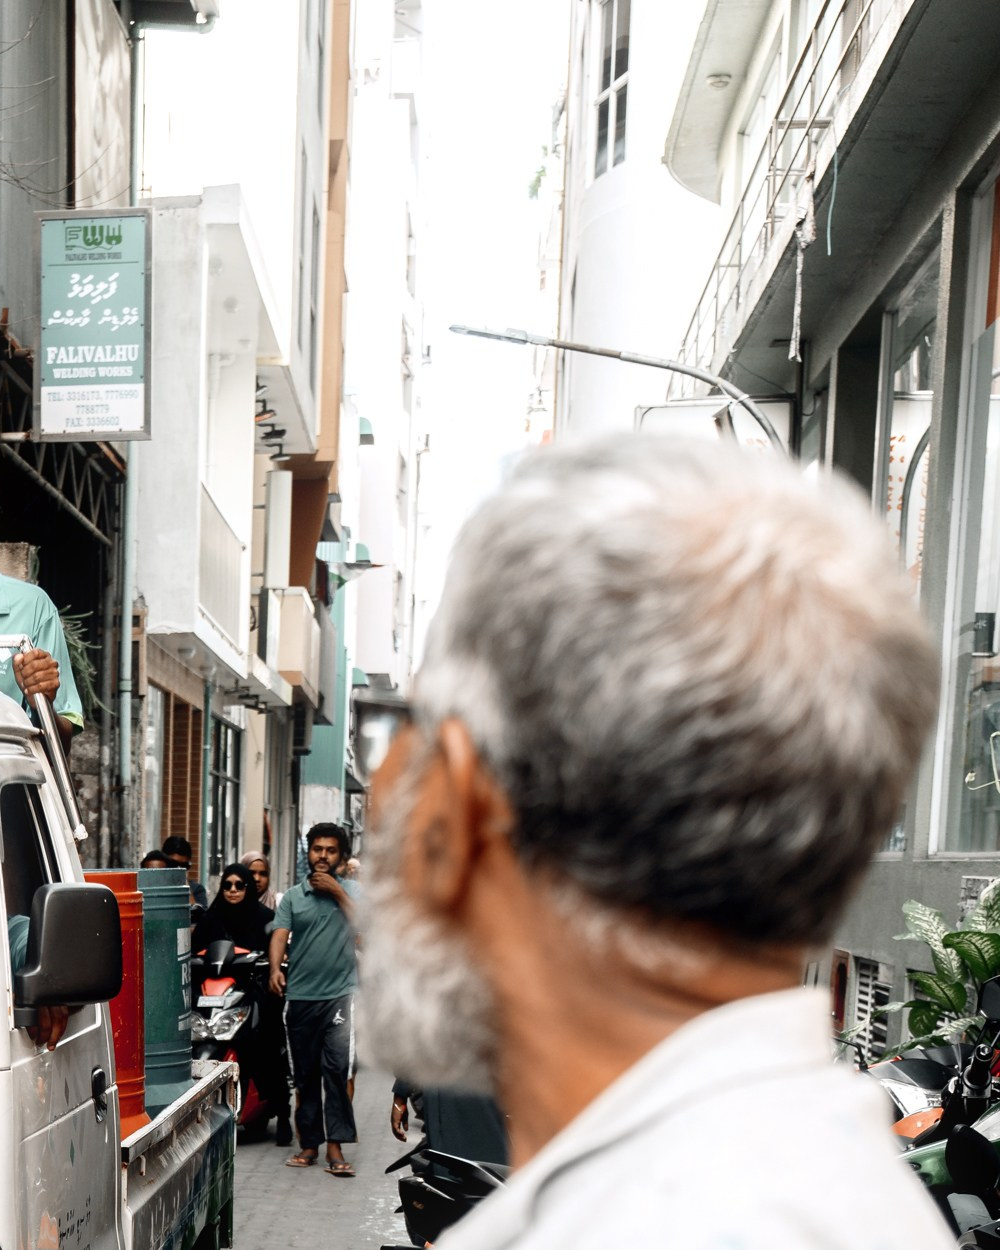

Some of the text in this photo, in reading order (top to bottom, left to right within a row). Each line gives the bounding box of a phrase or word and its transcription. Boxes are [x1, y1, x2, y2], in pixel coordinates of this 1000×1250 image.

[107, 251, 122, 260] WORKS
[46, 344, 139, 364] FALIVALHU
[53, 366, 133, 379] WELDING WORKS
